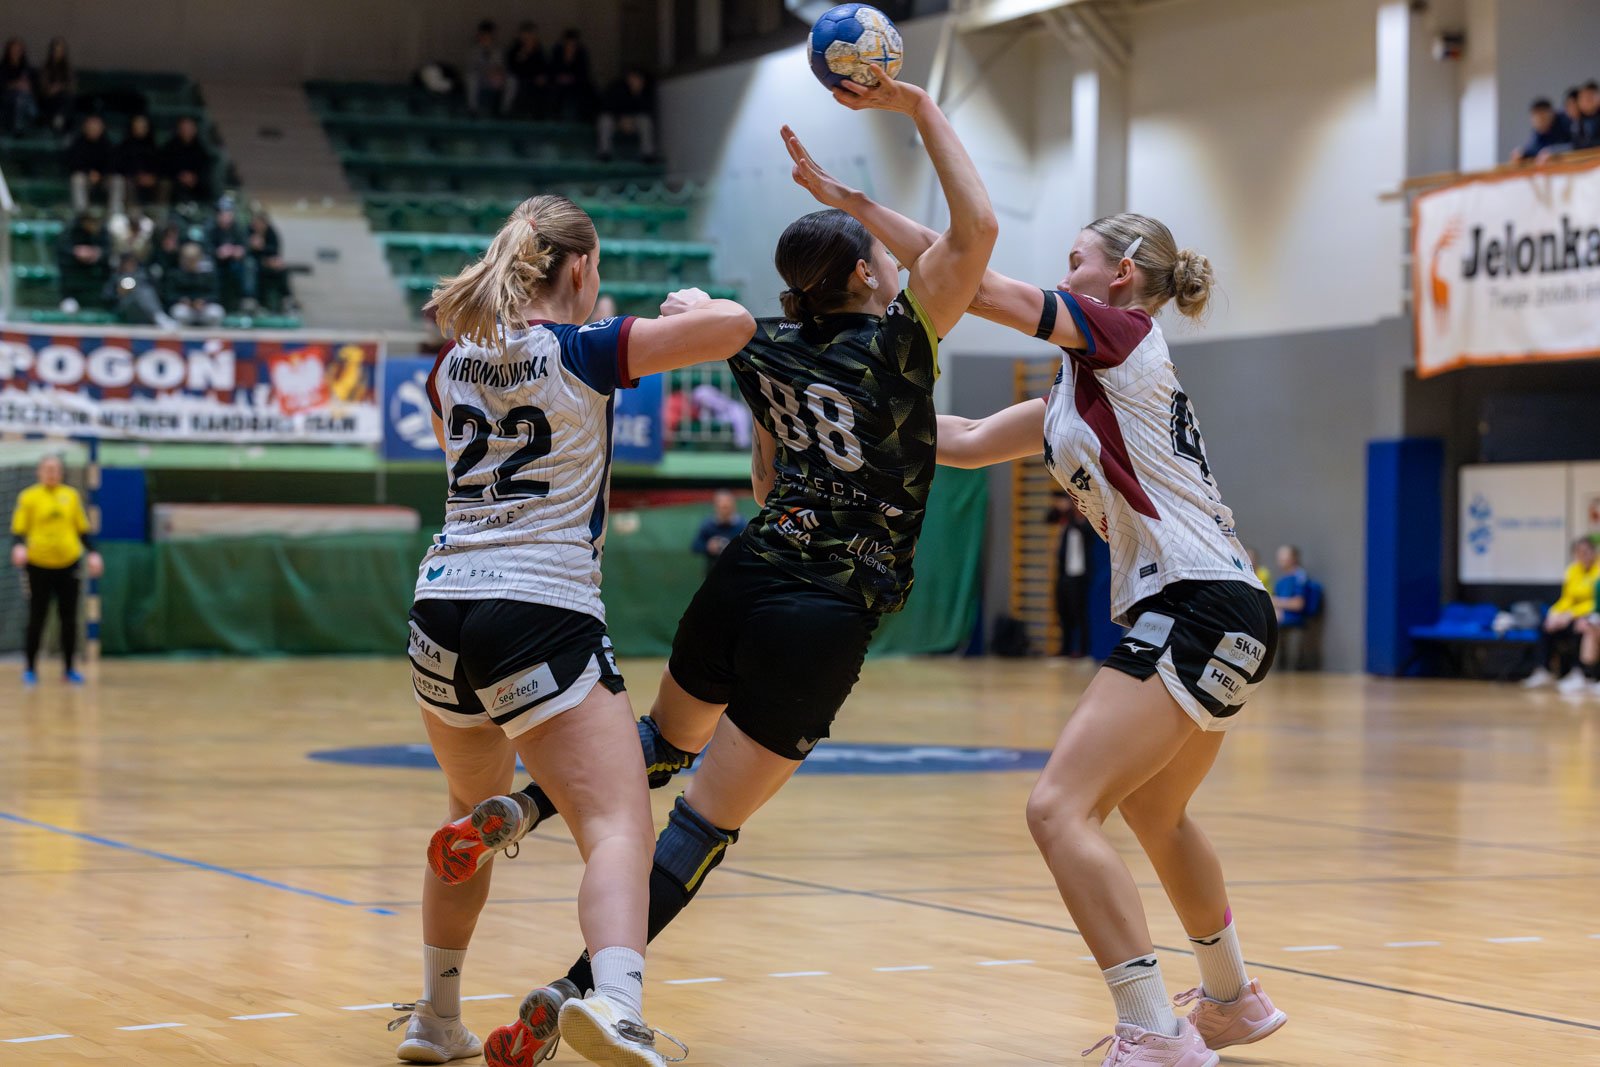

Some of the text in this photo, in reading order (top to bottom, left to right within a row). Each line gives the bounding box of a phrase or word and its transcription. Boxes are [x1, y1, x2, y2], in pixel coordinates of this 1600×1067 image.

[1462, 214, 1600, 279] Jelonka
[0, 338, 236, 389] POGOŃ
[447, 404, 552, 504] 22
[470, 569, 504, 578] STAL
[411, 630, 441, 663] KALA
[1234, 637, 1265, 662] SKAL
[498, 679, 538, 705] sea-tech
